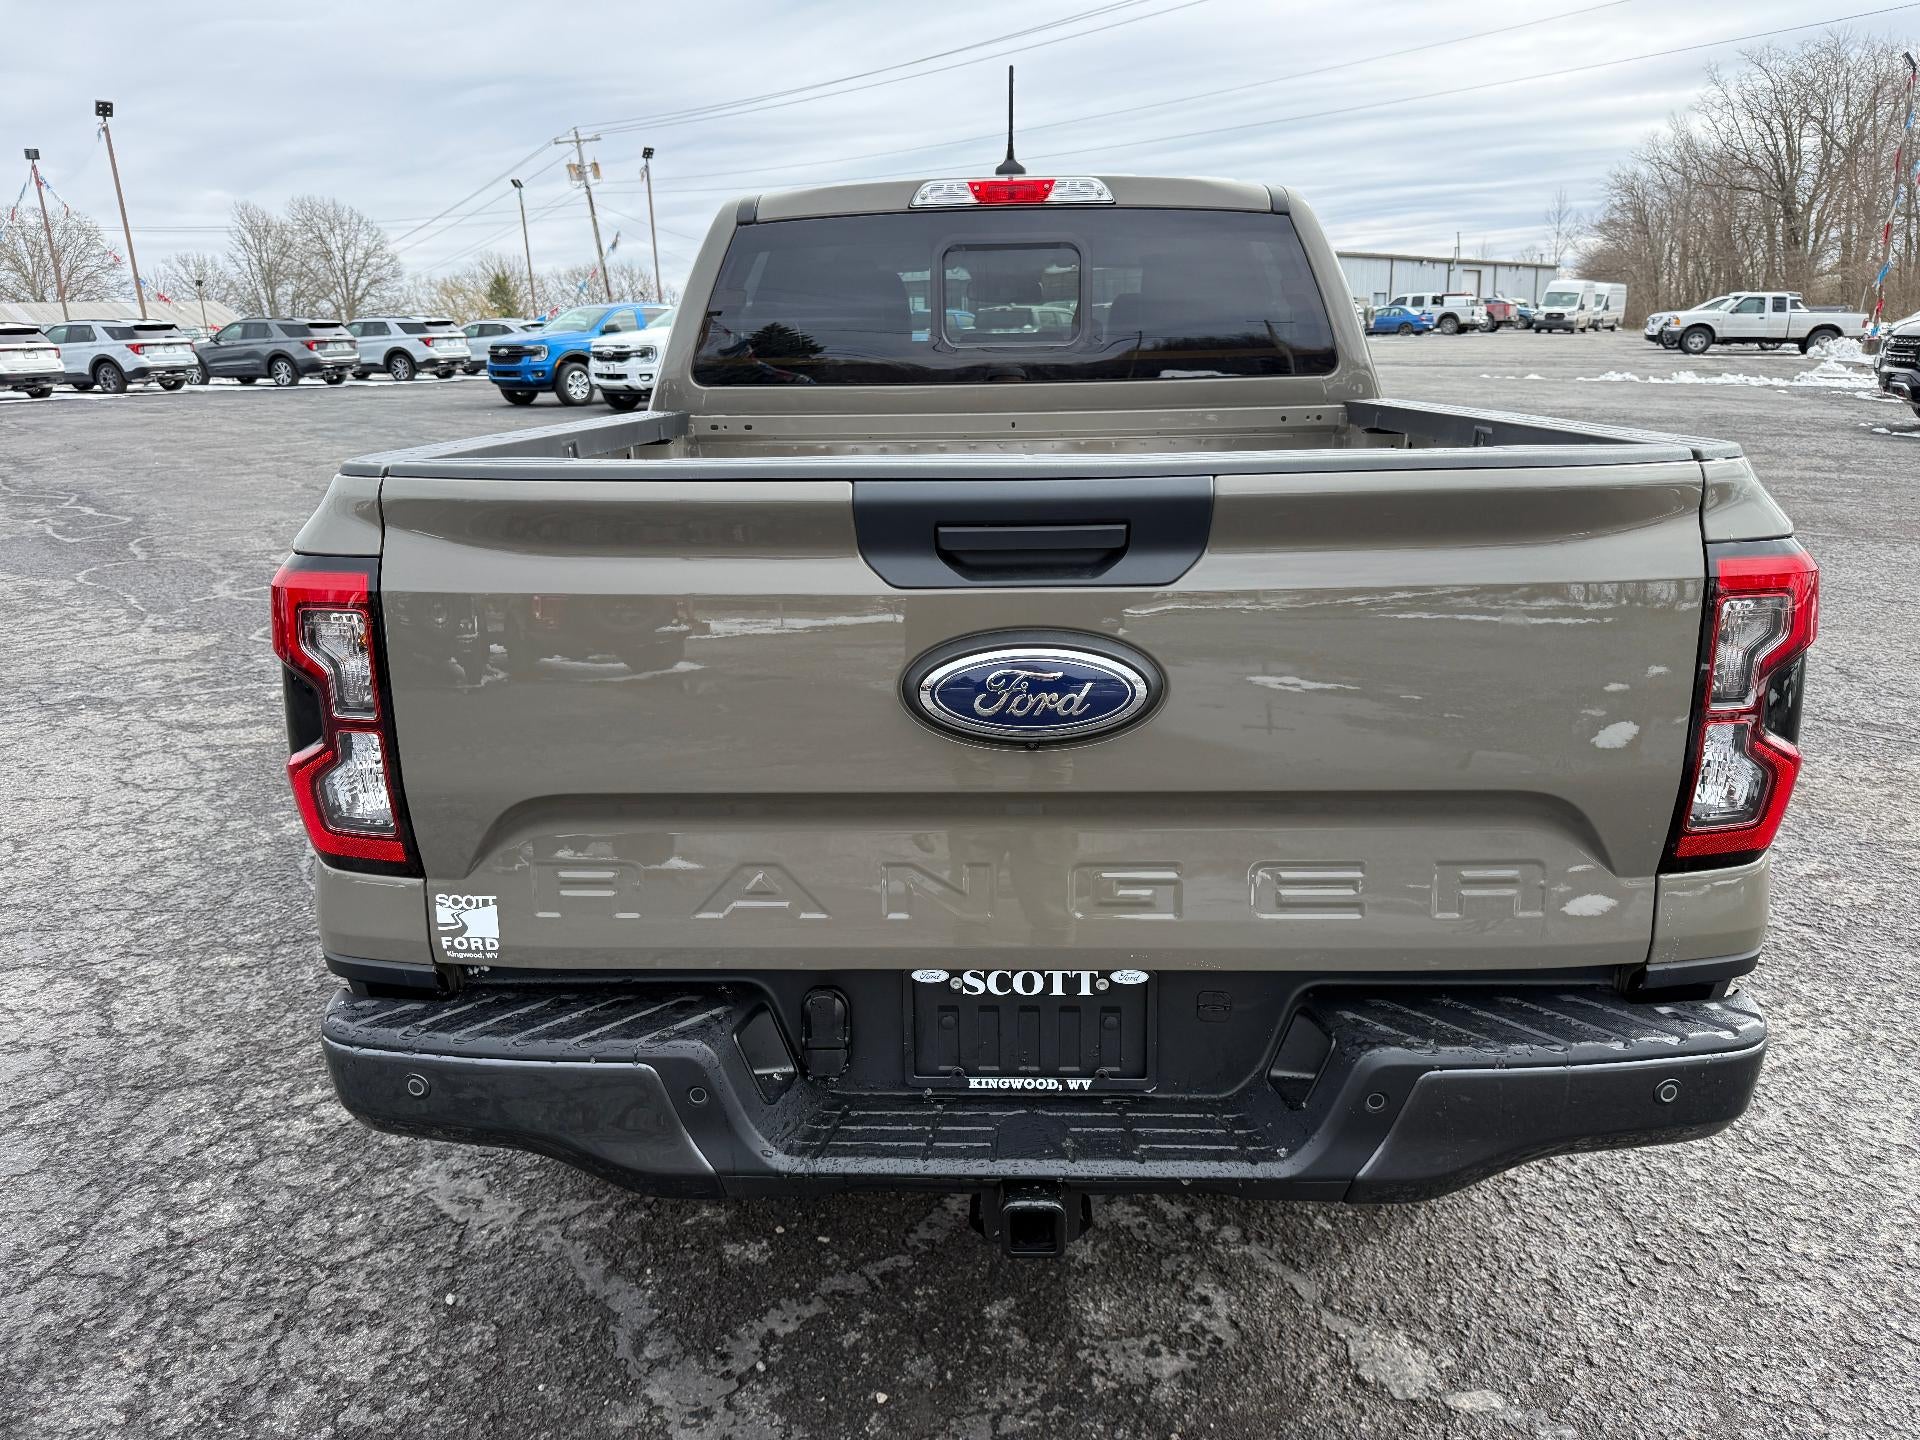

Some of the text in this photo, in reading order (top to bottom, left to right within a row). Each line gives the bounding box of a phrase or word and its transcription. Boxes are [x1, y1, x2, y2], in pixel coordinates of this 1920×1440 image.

[974, 669, 1097, 716] Ford
[532, 860, 1548, 920] RANGER
[435, 893, 497, 910] SCOTT
[440, 936, 500, 951] FORD
[446, 950, 485, 959] Kingwood,
[962, 970, 1099, 996] SCOTT
[968, 1078, 1093, 1091] KINGWOOD, WV
